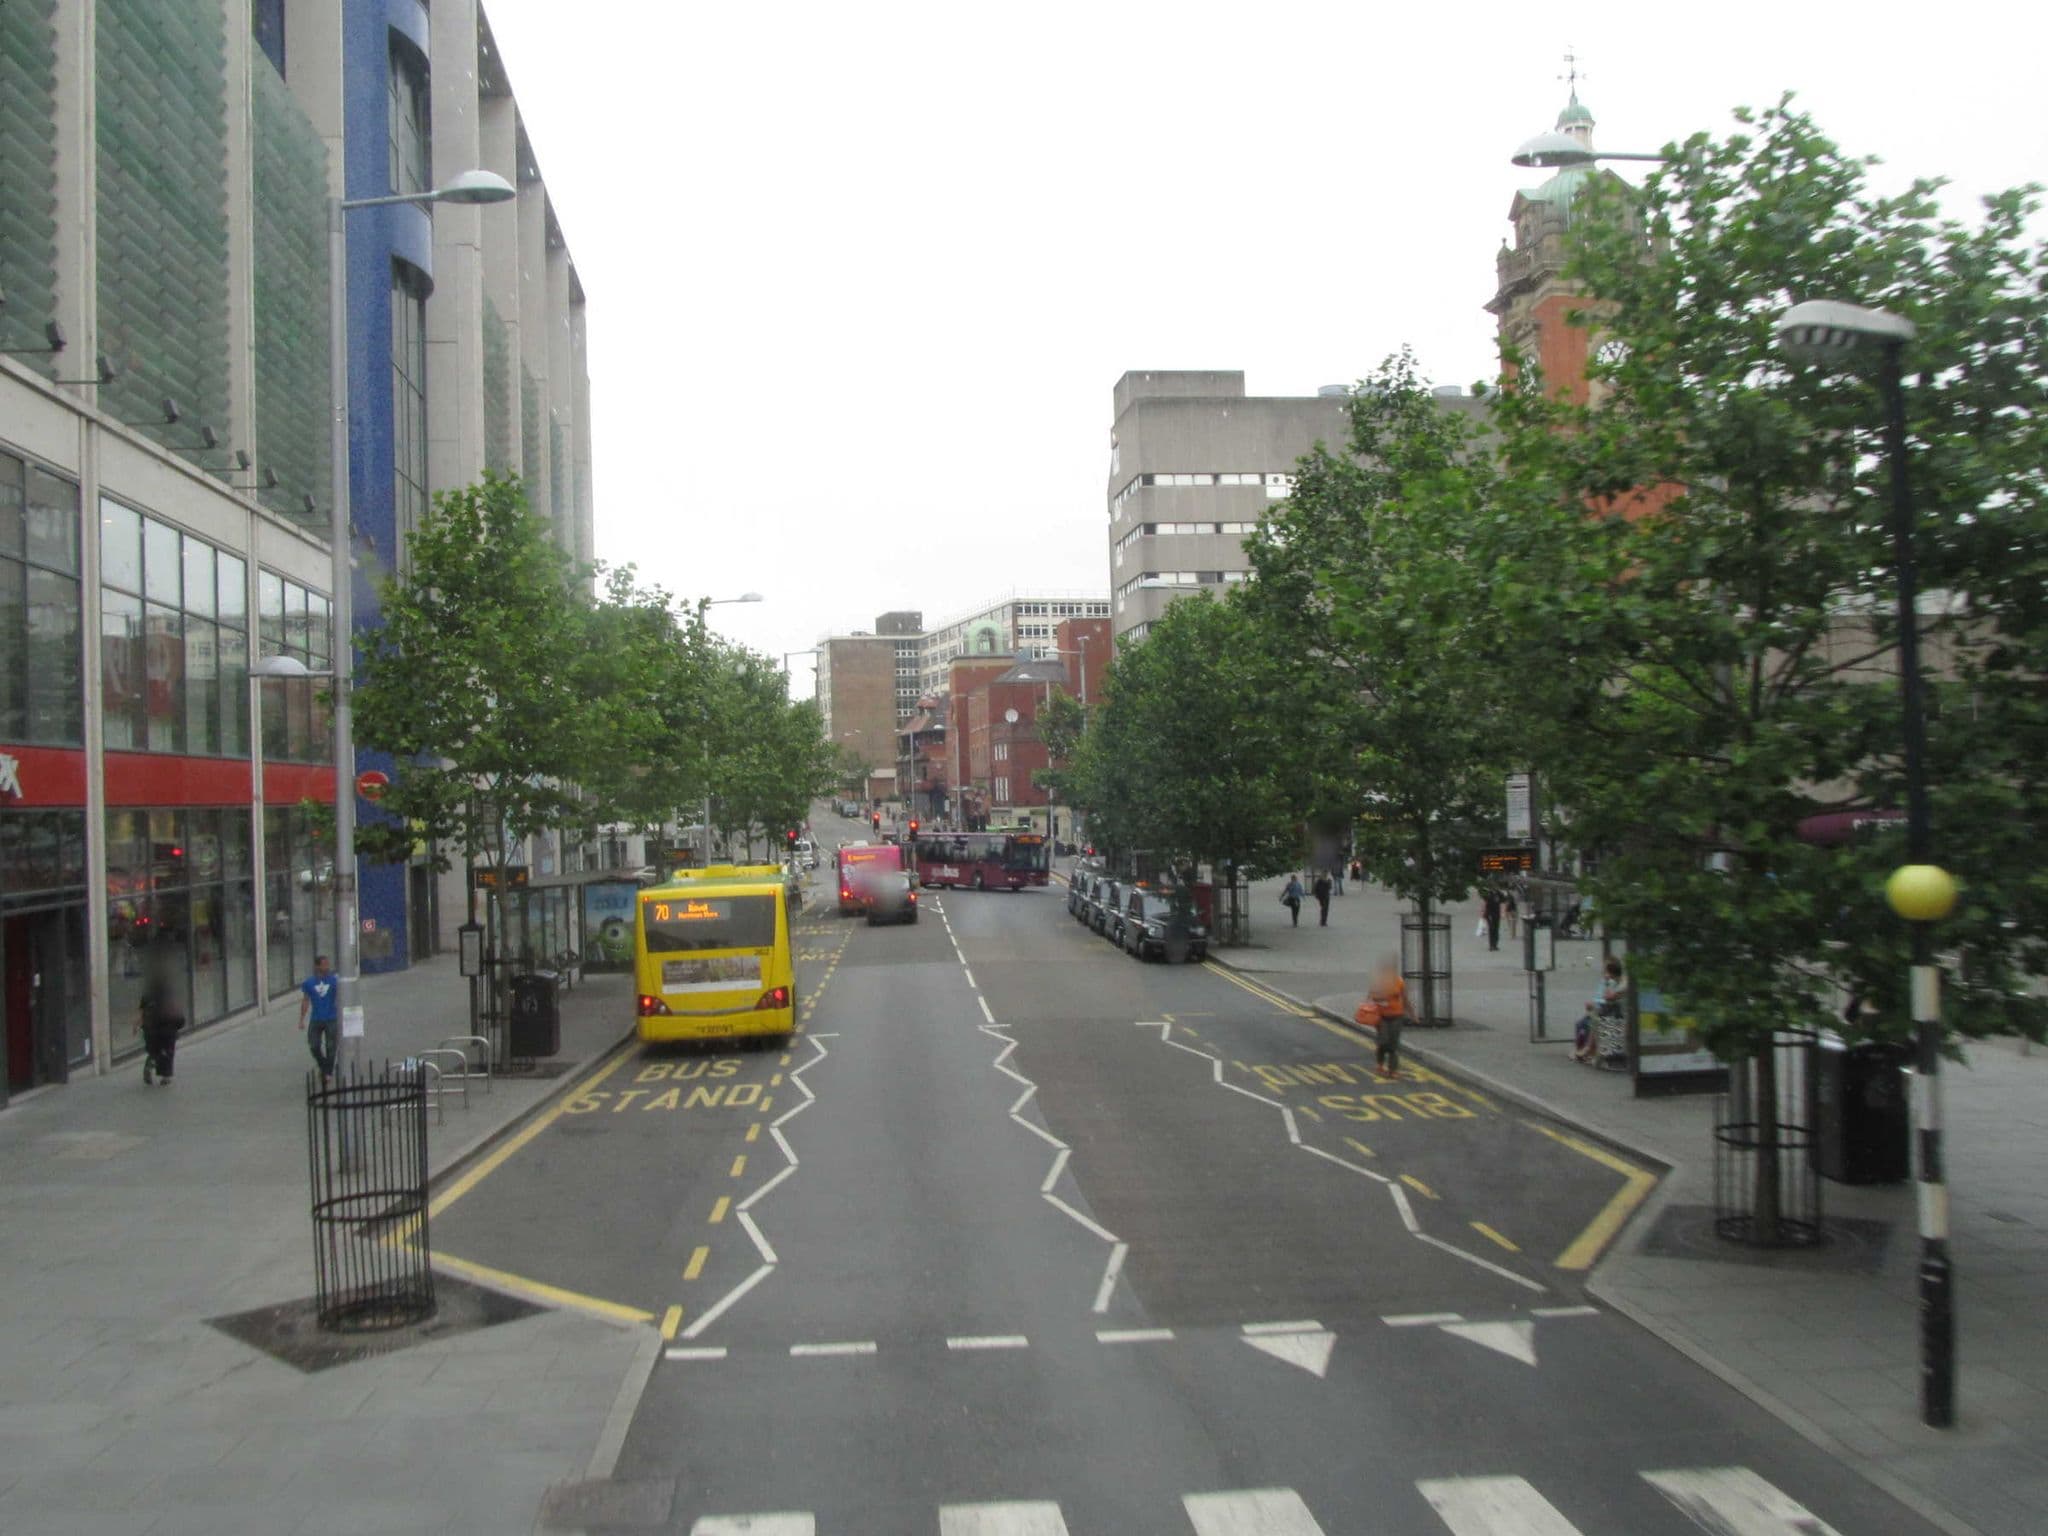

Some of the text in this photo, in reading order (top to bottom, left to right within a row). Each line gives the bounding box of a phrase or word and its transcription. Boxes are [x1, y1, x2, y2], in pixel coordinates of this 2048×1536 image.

[655, 903, 670, 921] 70
[634, 1058, 743, 1083] BUS
[562, 1083, 764, 1114] STAND
[1317, 1092, 1478, 1121] BUS
